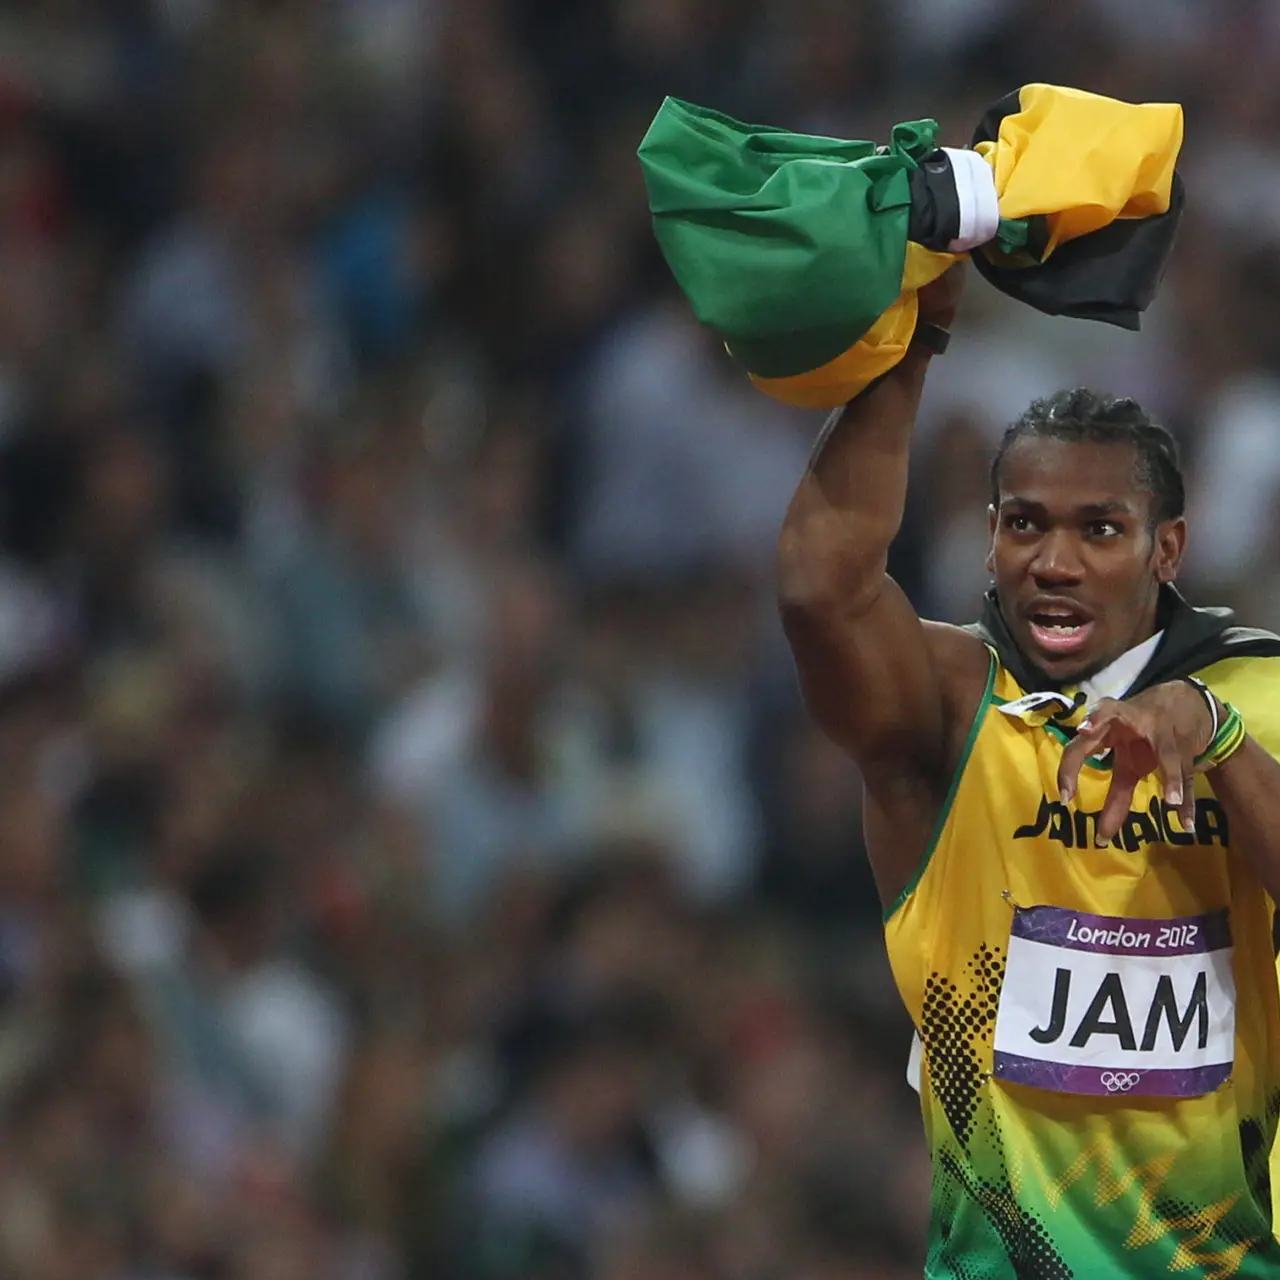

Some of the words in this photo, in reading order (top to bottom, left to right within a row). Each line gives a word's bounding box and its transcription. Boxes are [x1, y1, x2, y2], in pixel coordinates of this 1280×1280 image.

[1066, 918, 1150, 948] London
[1155, 924, 1199, 948] 2012
[1028, 967, 1210, 1053] JAM
